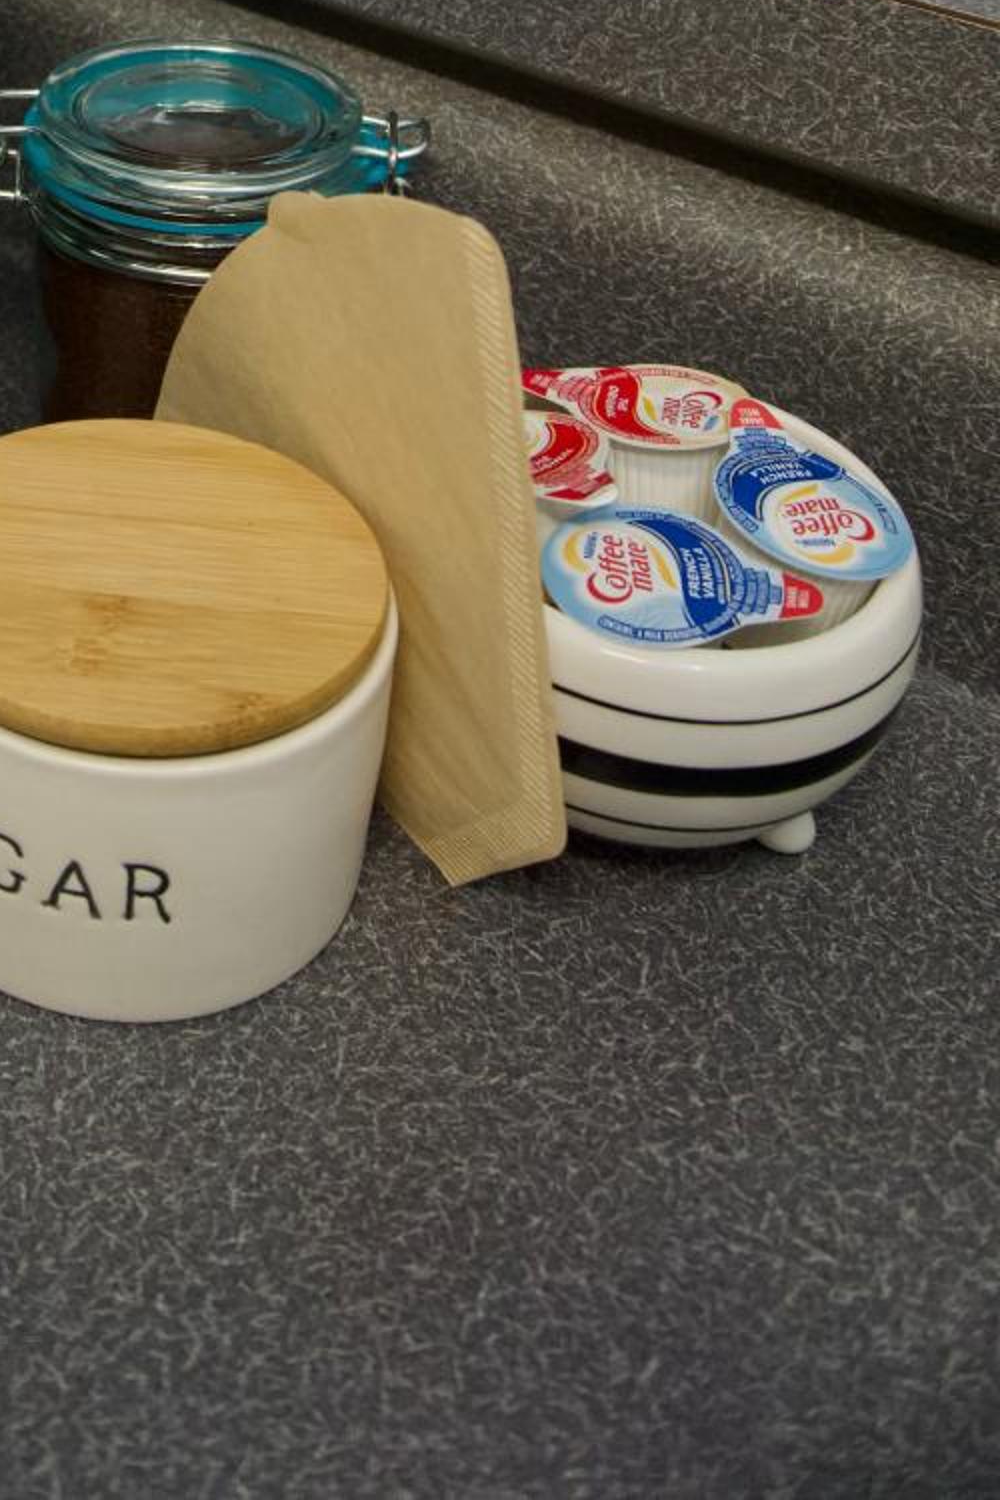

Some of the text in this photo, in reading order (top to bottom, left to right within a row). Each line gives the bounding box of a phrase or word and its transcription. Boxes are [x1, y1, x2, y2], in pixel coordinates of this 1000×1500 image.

[785, 497, 840, 517] mate
[792, 509, 875, 541] Coffee
[587, 534, 633, 604] Coffee
[631, 540, 653, 592] mate
[679, 547, 701, 599] FRENCH
[695, 547, 715, 599] VANILLA
